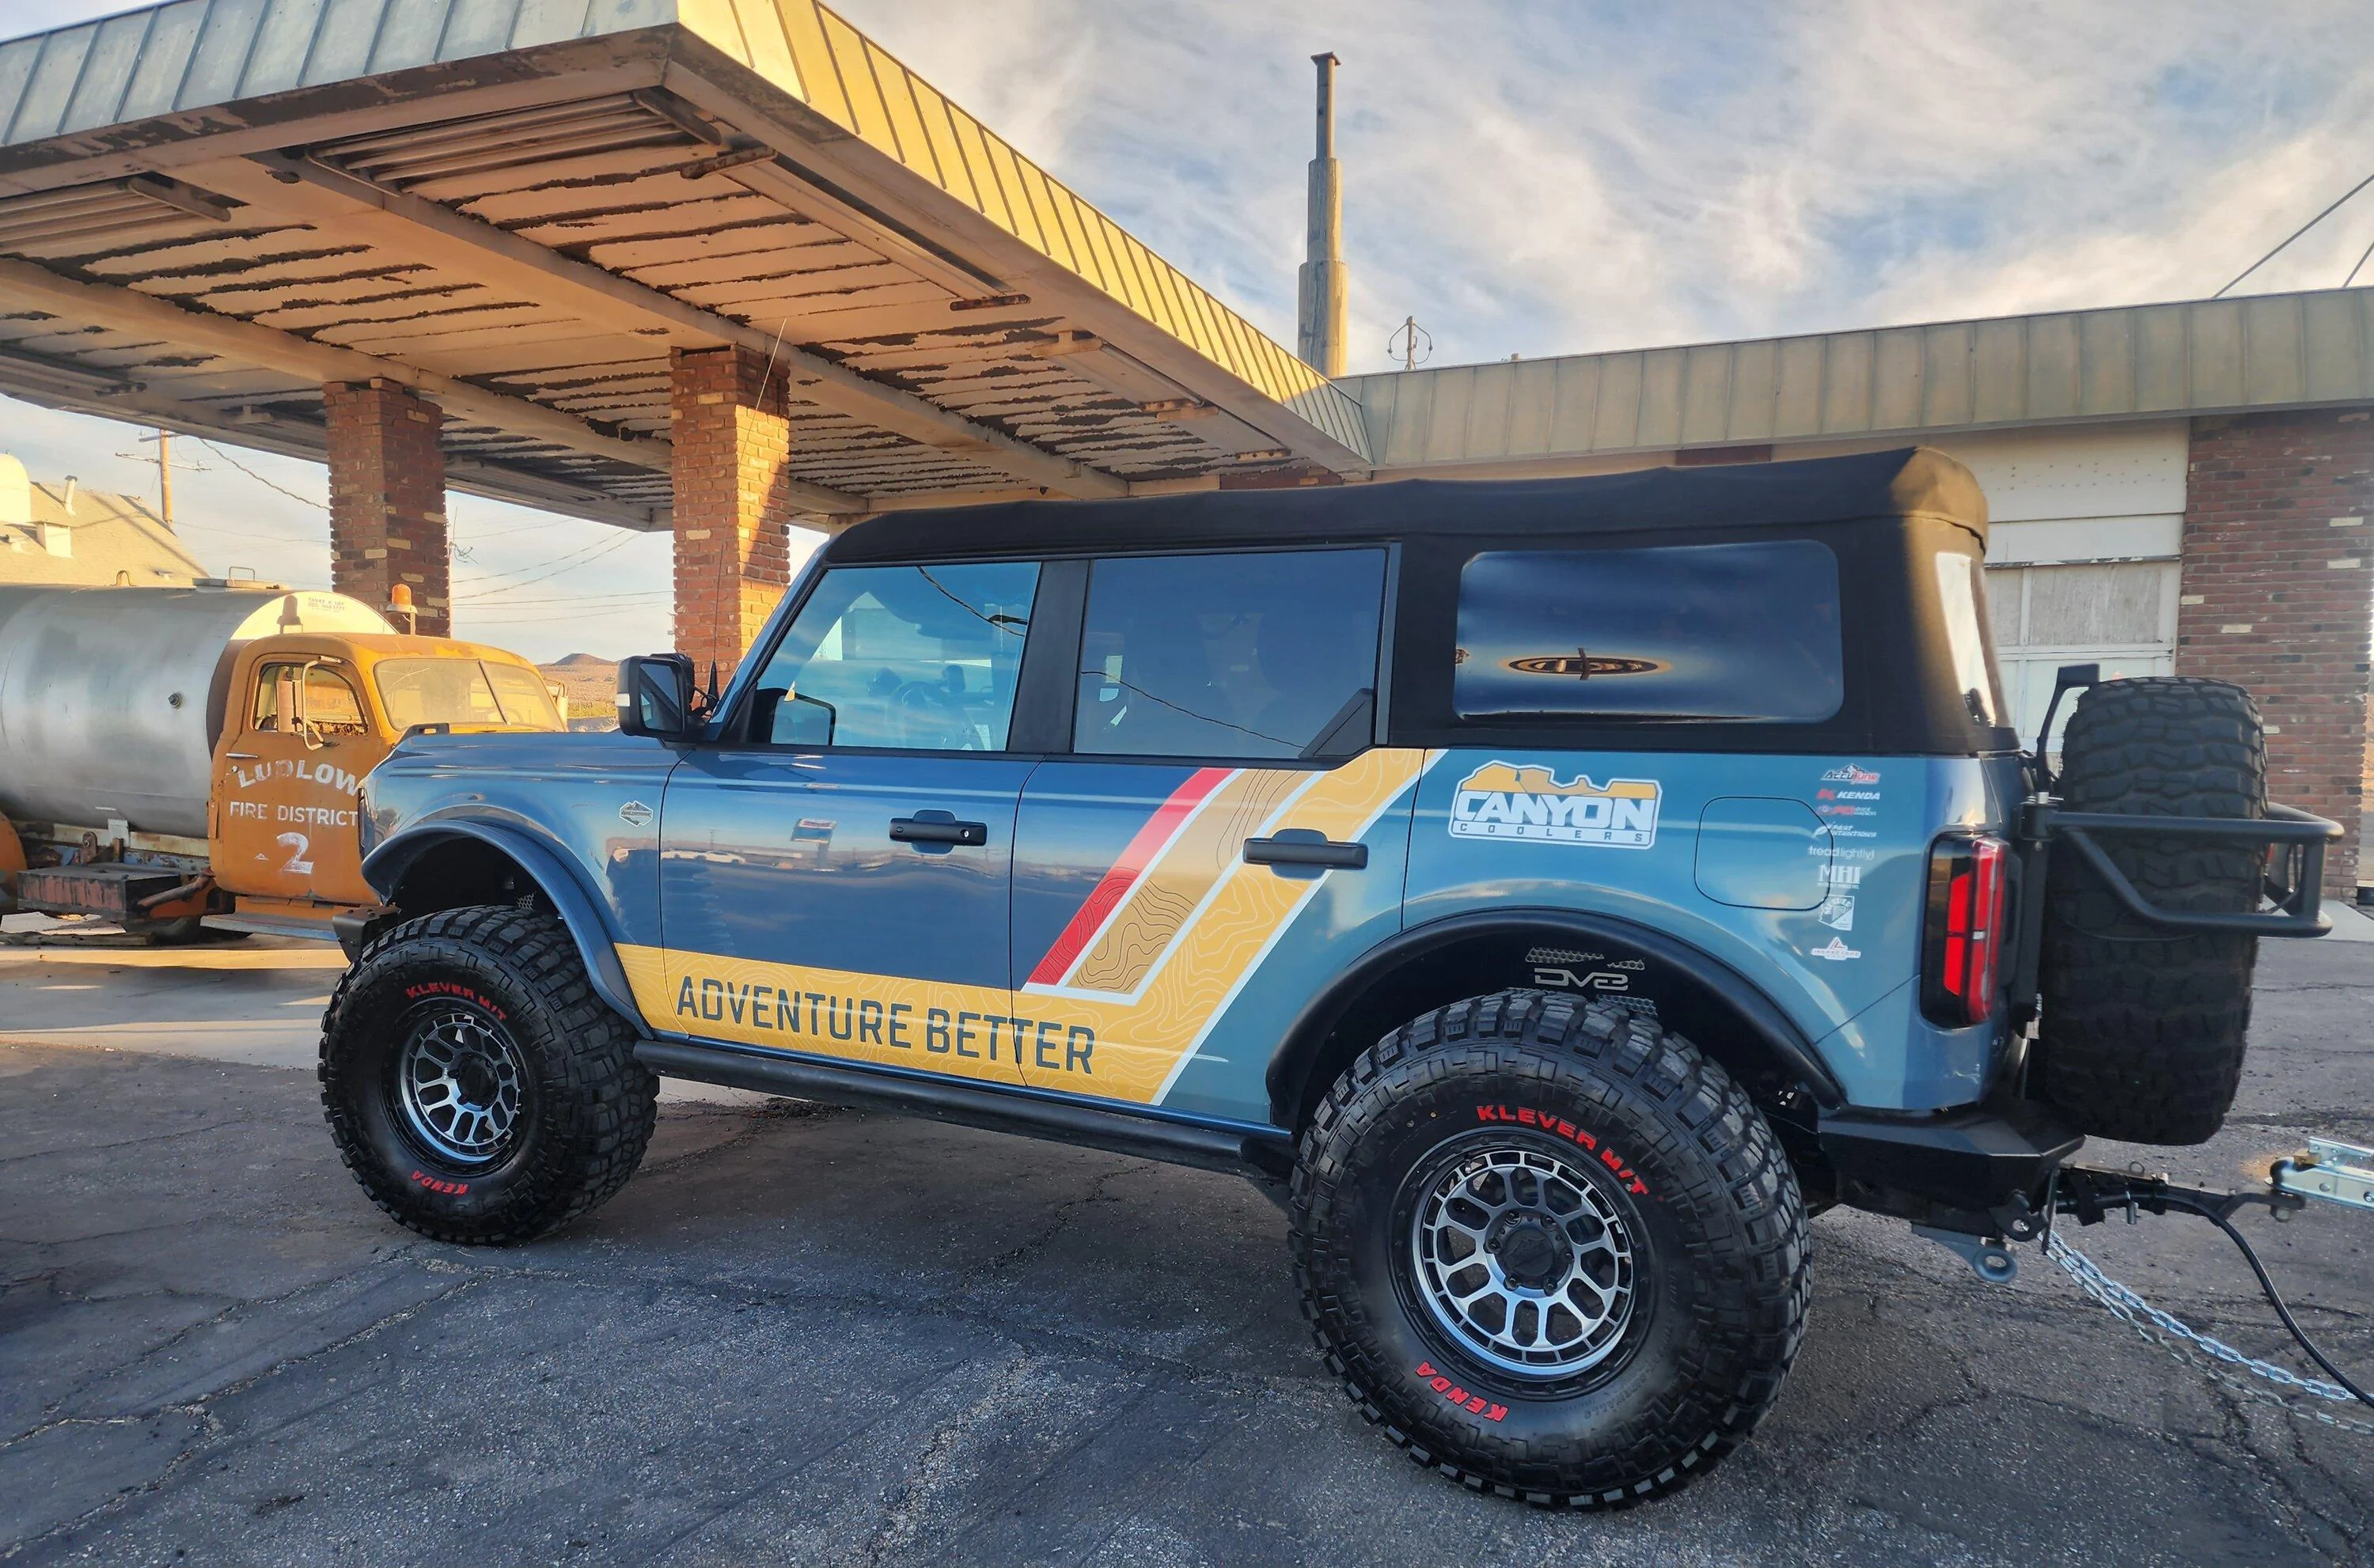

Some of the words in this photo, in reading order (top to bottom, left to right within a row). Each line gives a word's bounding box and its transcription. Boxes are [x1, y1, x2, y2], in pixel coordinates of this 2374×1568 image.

[237, 759, 359, 797] LUDLOW
[1837, 791, 1880, 800] KENDA
[229, 801, 267, 820] FIRE
[278, 805, 358, 827] DISTRICT
[1454, 790, 1655, 831] CANYON
[1459, 823, 1643, 843] COOLERS
[276, 831, 314, 874] 2
[1818, 864, 1861, 884] MHI
[406, 982, 475, 999] KLEVER
[479, 995, 506, 1021] M/T
[677, 975, 912, 1049] ADVENTURE
[927, 1008, 1095, 1075] BETTER
[1476, 1104, 1598, 1151] KLEVER
[1600, 1146, 1649, 1195] M/T
[411, 1169, 469, 1197] KENDA
[1415, 1361, 1509, 1422] KENDA
